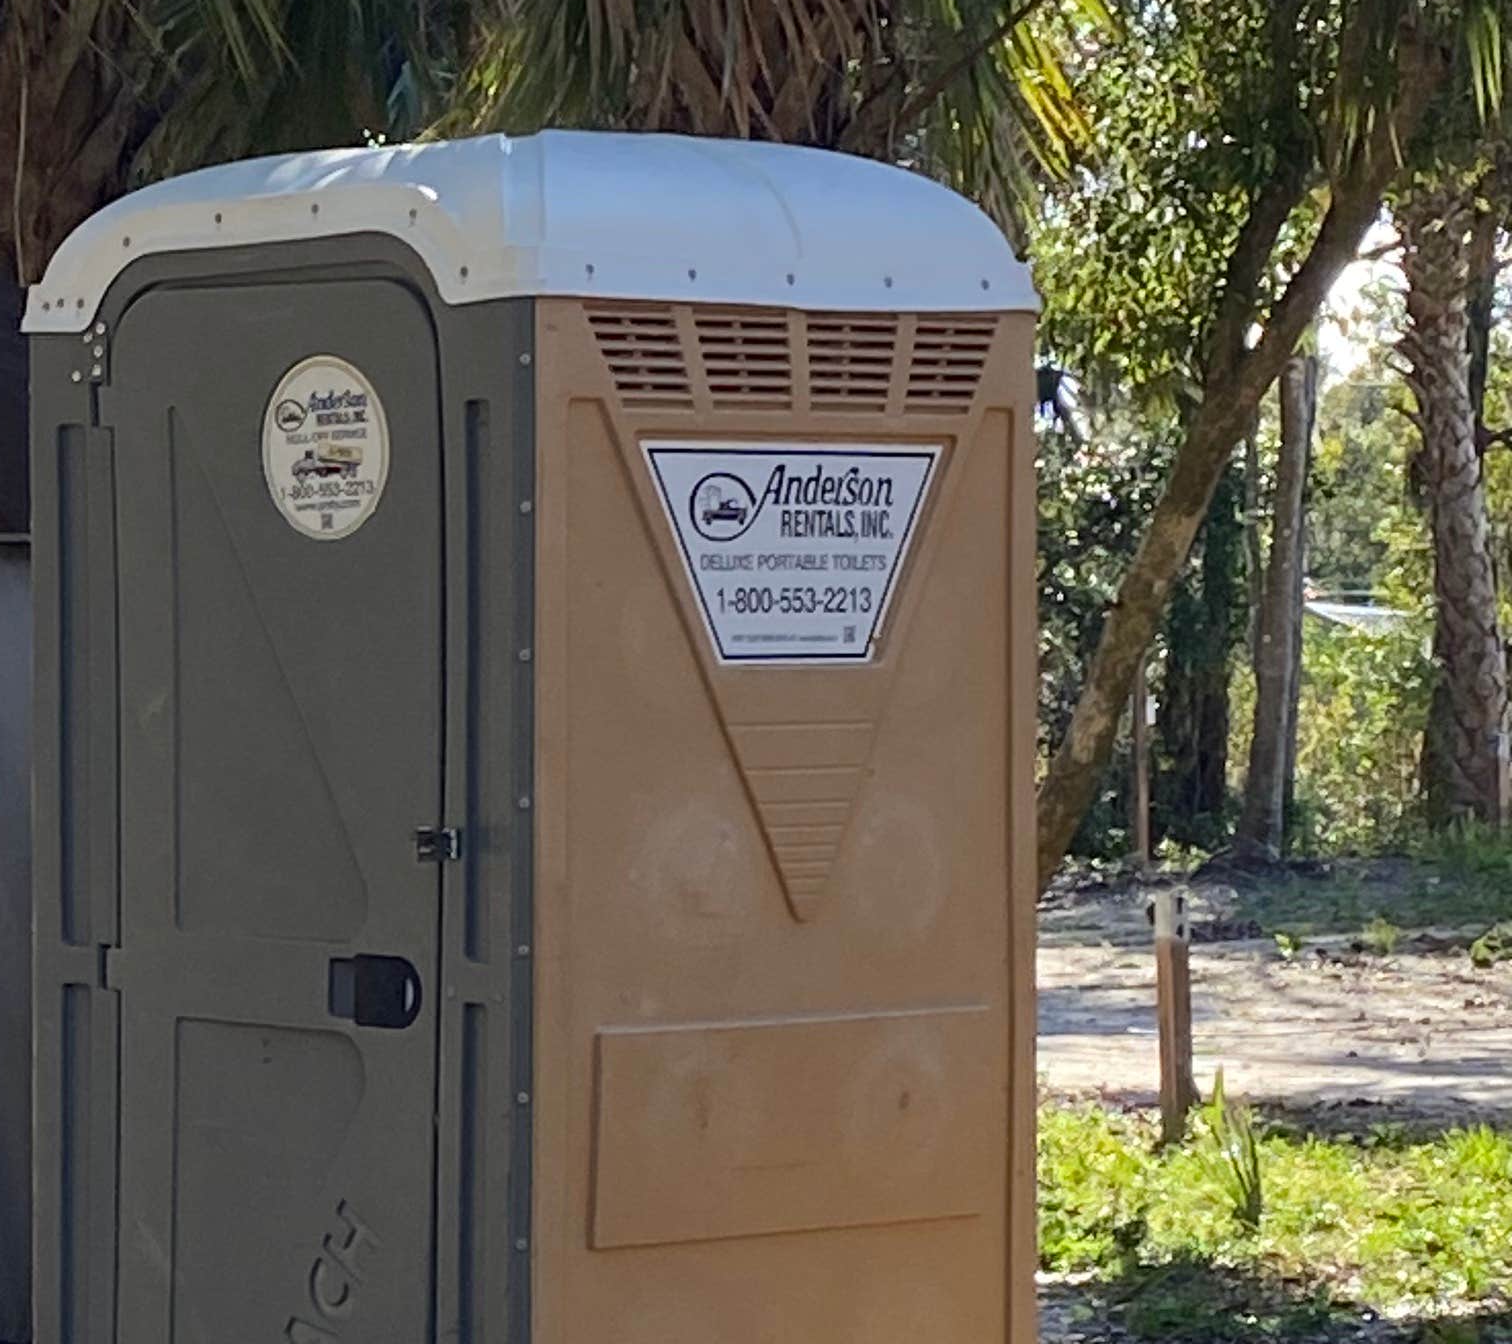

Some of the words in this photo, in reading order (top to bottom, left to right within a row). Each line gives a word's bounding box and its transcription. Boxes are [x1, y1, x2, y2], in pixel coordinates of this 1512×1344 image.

[760, 464, 894, 506] Anderson
[780, 509, 859, 542] RENTALS,
[861, 509, 894, 539] INC.
[700, 554, 754, 571] DELUXE
[757, 554, 829, 571] PORTABLE
[832, 554, 888, 571] TOILETS
[716, 587, 872, 614] 1-800-553-2213
